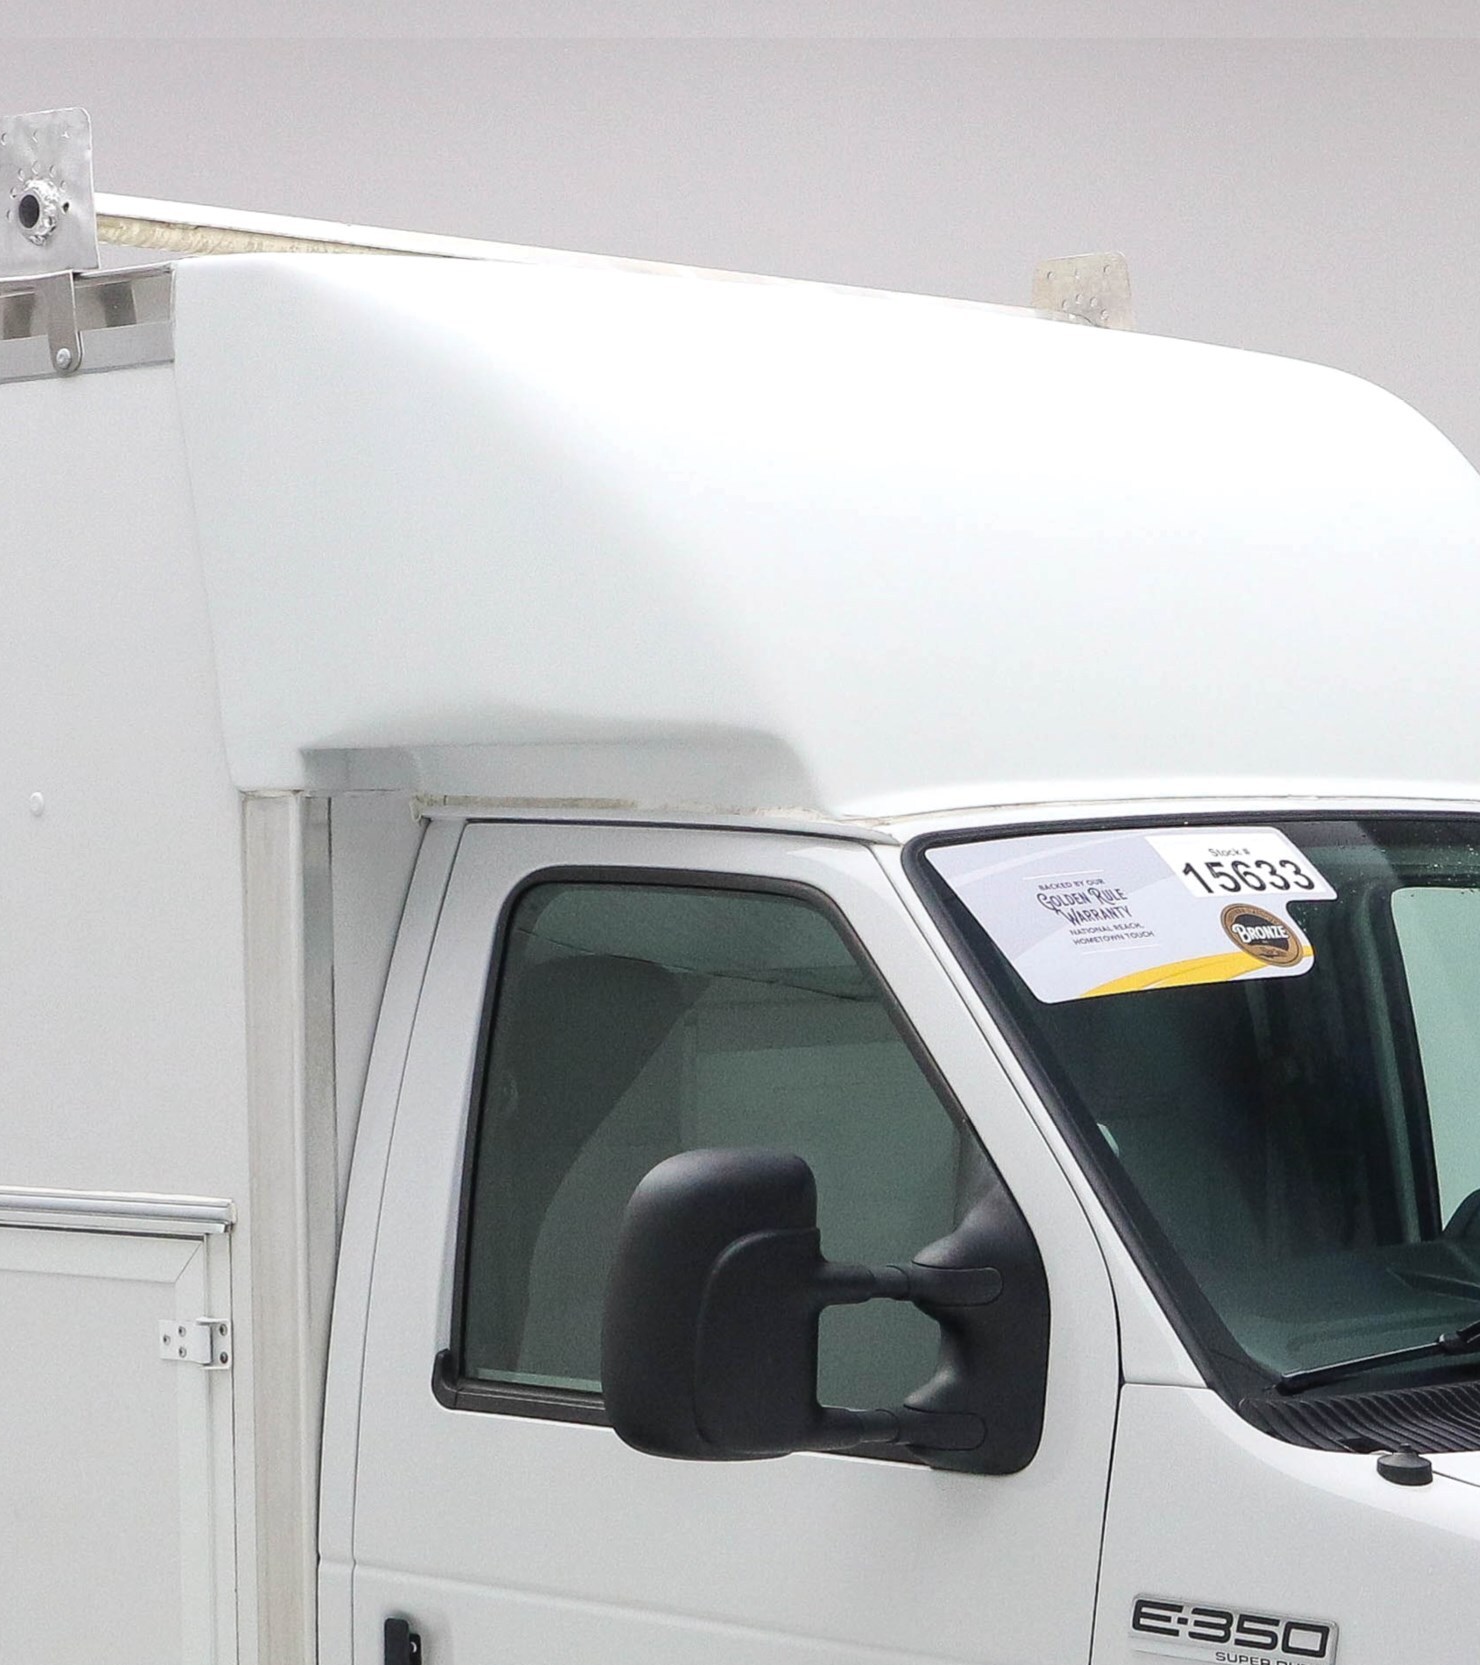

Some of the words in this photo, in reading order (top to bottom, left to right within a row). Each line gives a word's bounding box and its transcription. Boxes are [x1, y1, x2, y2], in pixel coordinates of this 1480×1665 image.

[1208, 848, 1240, 858] Stock
[1073, 880, 1086, 889] BY
[1086, 878, 1105, 887] OUR
[1182, 860, 1315, 894] 15633
[1037, 890, 1091, 911] GOLDEN
[1087, 887, 1128, 906] RULE
[1056, 905, 1132, 926] WARRANTY
[1125, 930, 1155, 941] TOUCH
[1231, 923, 1289, 944] BRONZE
[1132, 1599, 1330, 1658] E-350
